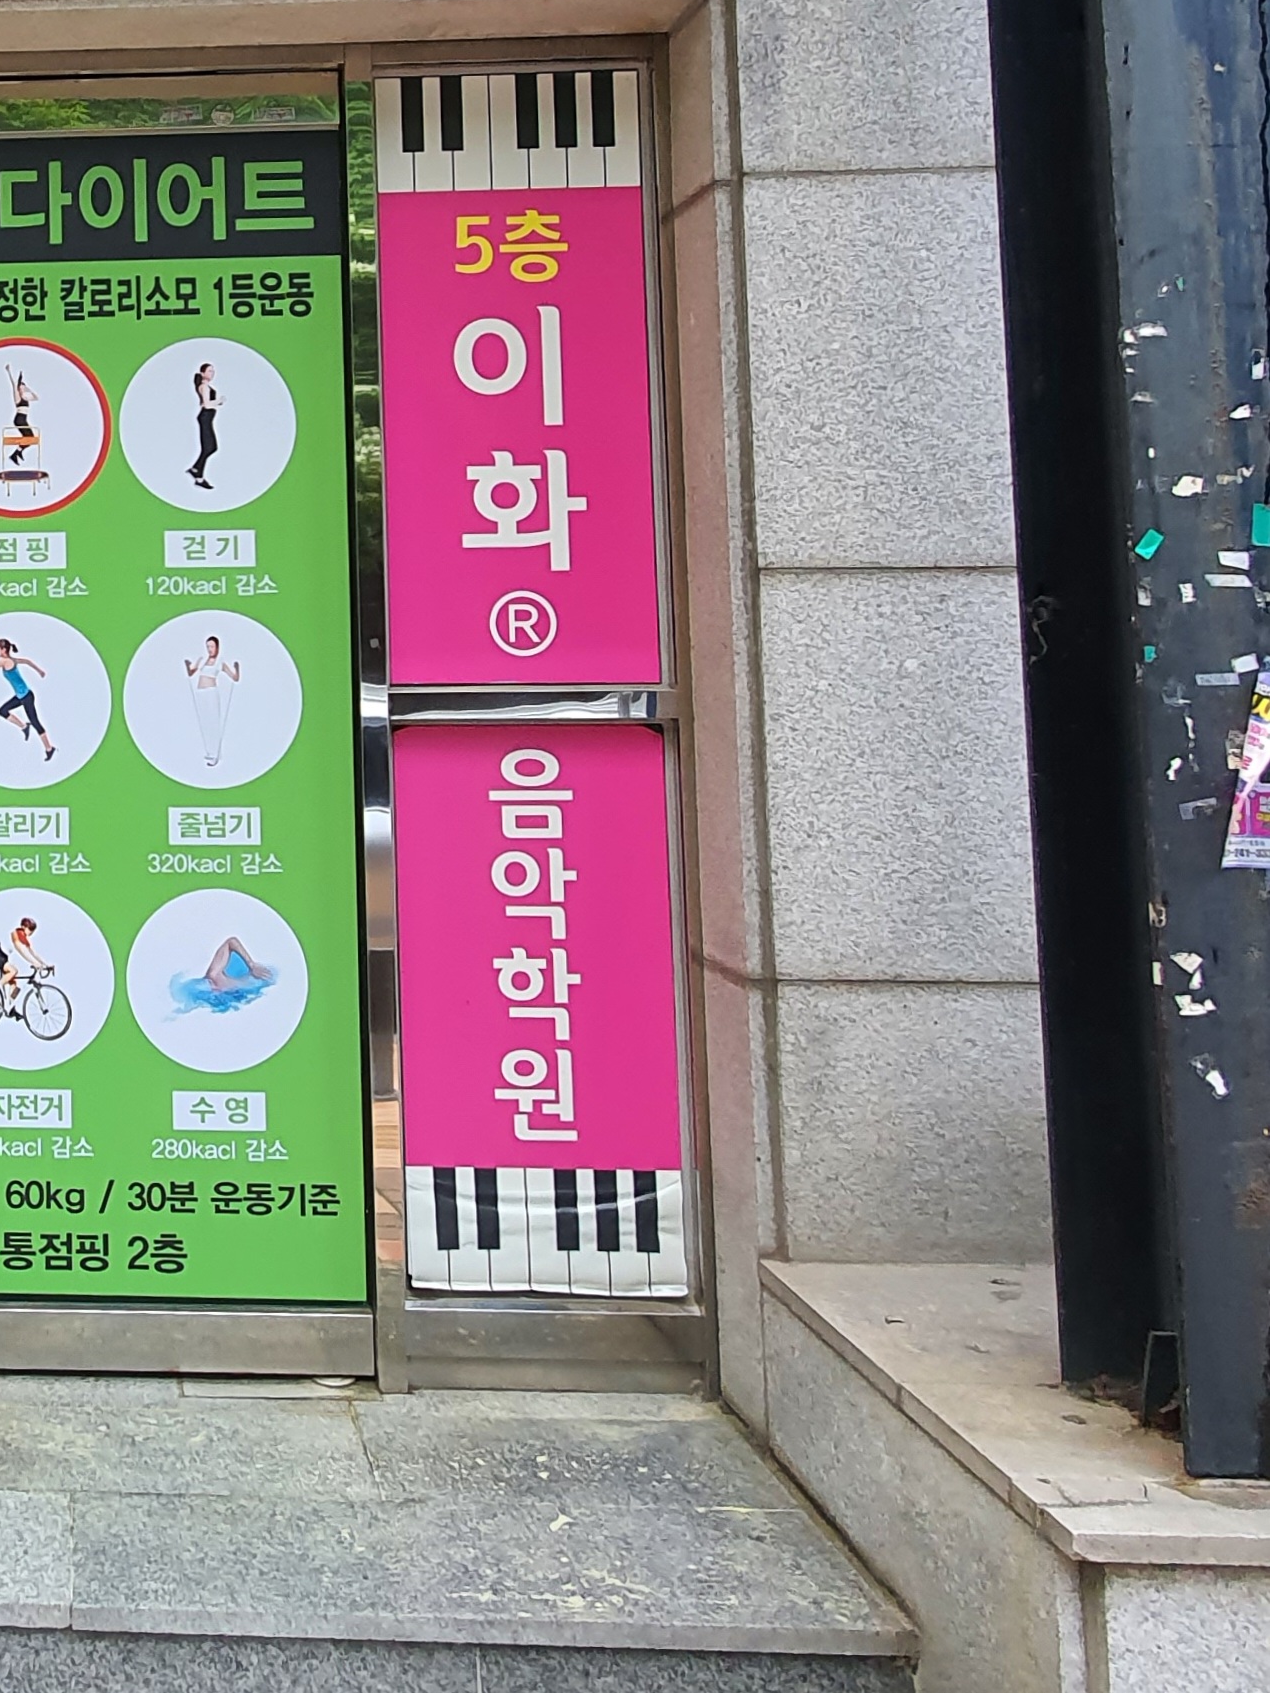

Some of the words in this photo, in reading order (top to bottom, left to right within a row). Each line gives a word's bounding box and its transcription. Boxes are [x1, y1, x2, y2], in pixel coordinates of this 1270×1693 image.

[454, 210, 569, 283] 5층
[59, 275, 198, 321] 칼로리소모
[212, 272, 314, 318] 1등운동
[453, 305, 587, 572] 이화
[182, 535, 239, 561] 걷기
[46, 576, 89, 598] 감소
[146, 576, 226, 596] 120kacl
[235, 574, 278, 596] 감소
[178, 812, 253, 838] 줄넘기
[48, 853, 91, 874] 감소
[148, 853, 230, 874] 320kacl
[240, 853, 283, 875] 감소
[488, 748, 581, 1142] 음악학원
[189, 1096, 250, 1124] 수영
[51, 1136, 94, 1158] 감소
[151, 1139, 235, 1160] 280kacl
[245, 1139, 288, 1162] 감소
[5, 1180, 86, 1213] 60kg
[127, 1181, 198, 1214] 30분
[209, 1181, 341, 1216] 운동기준
[127, 1233, 188, 1274] 2층
